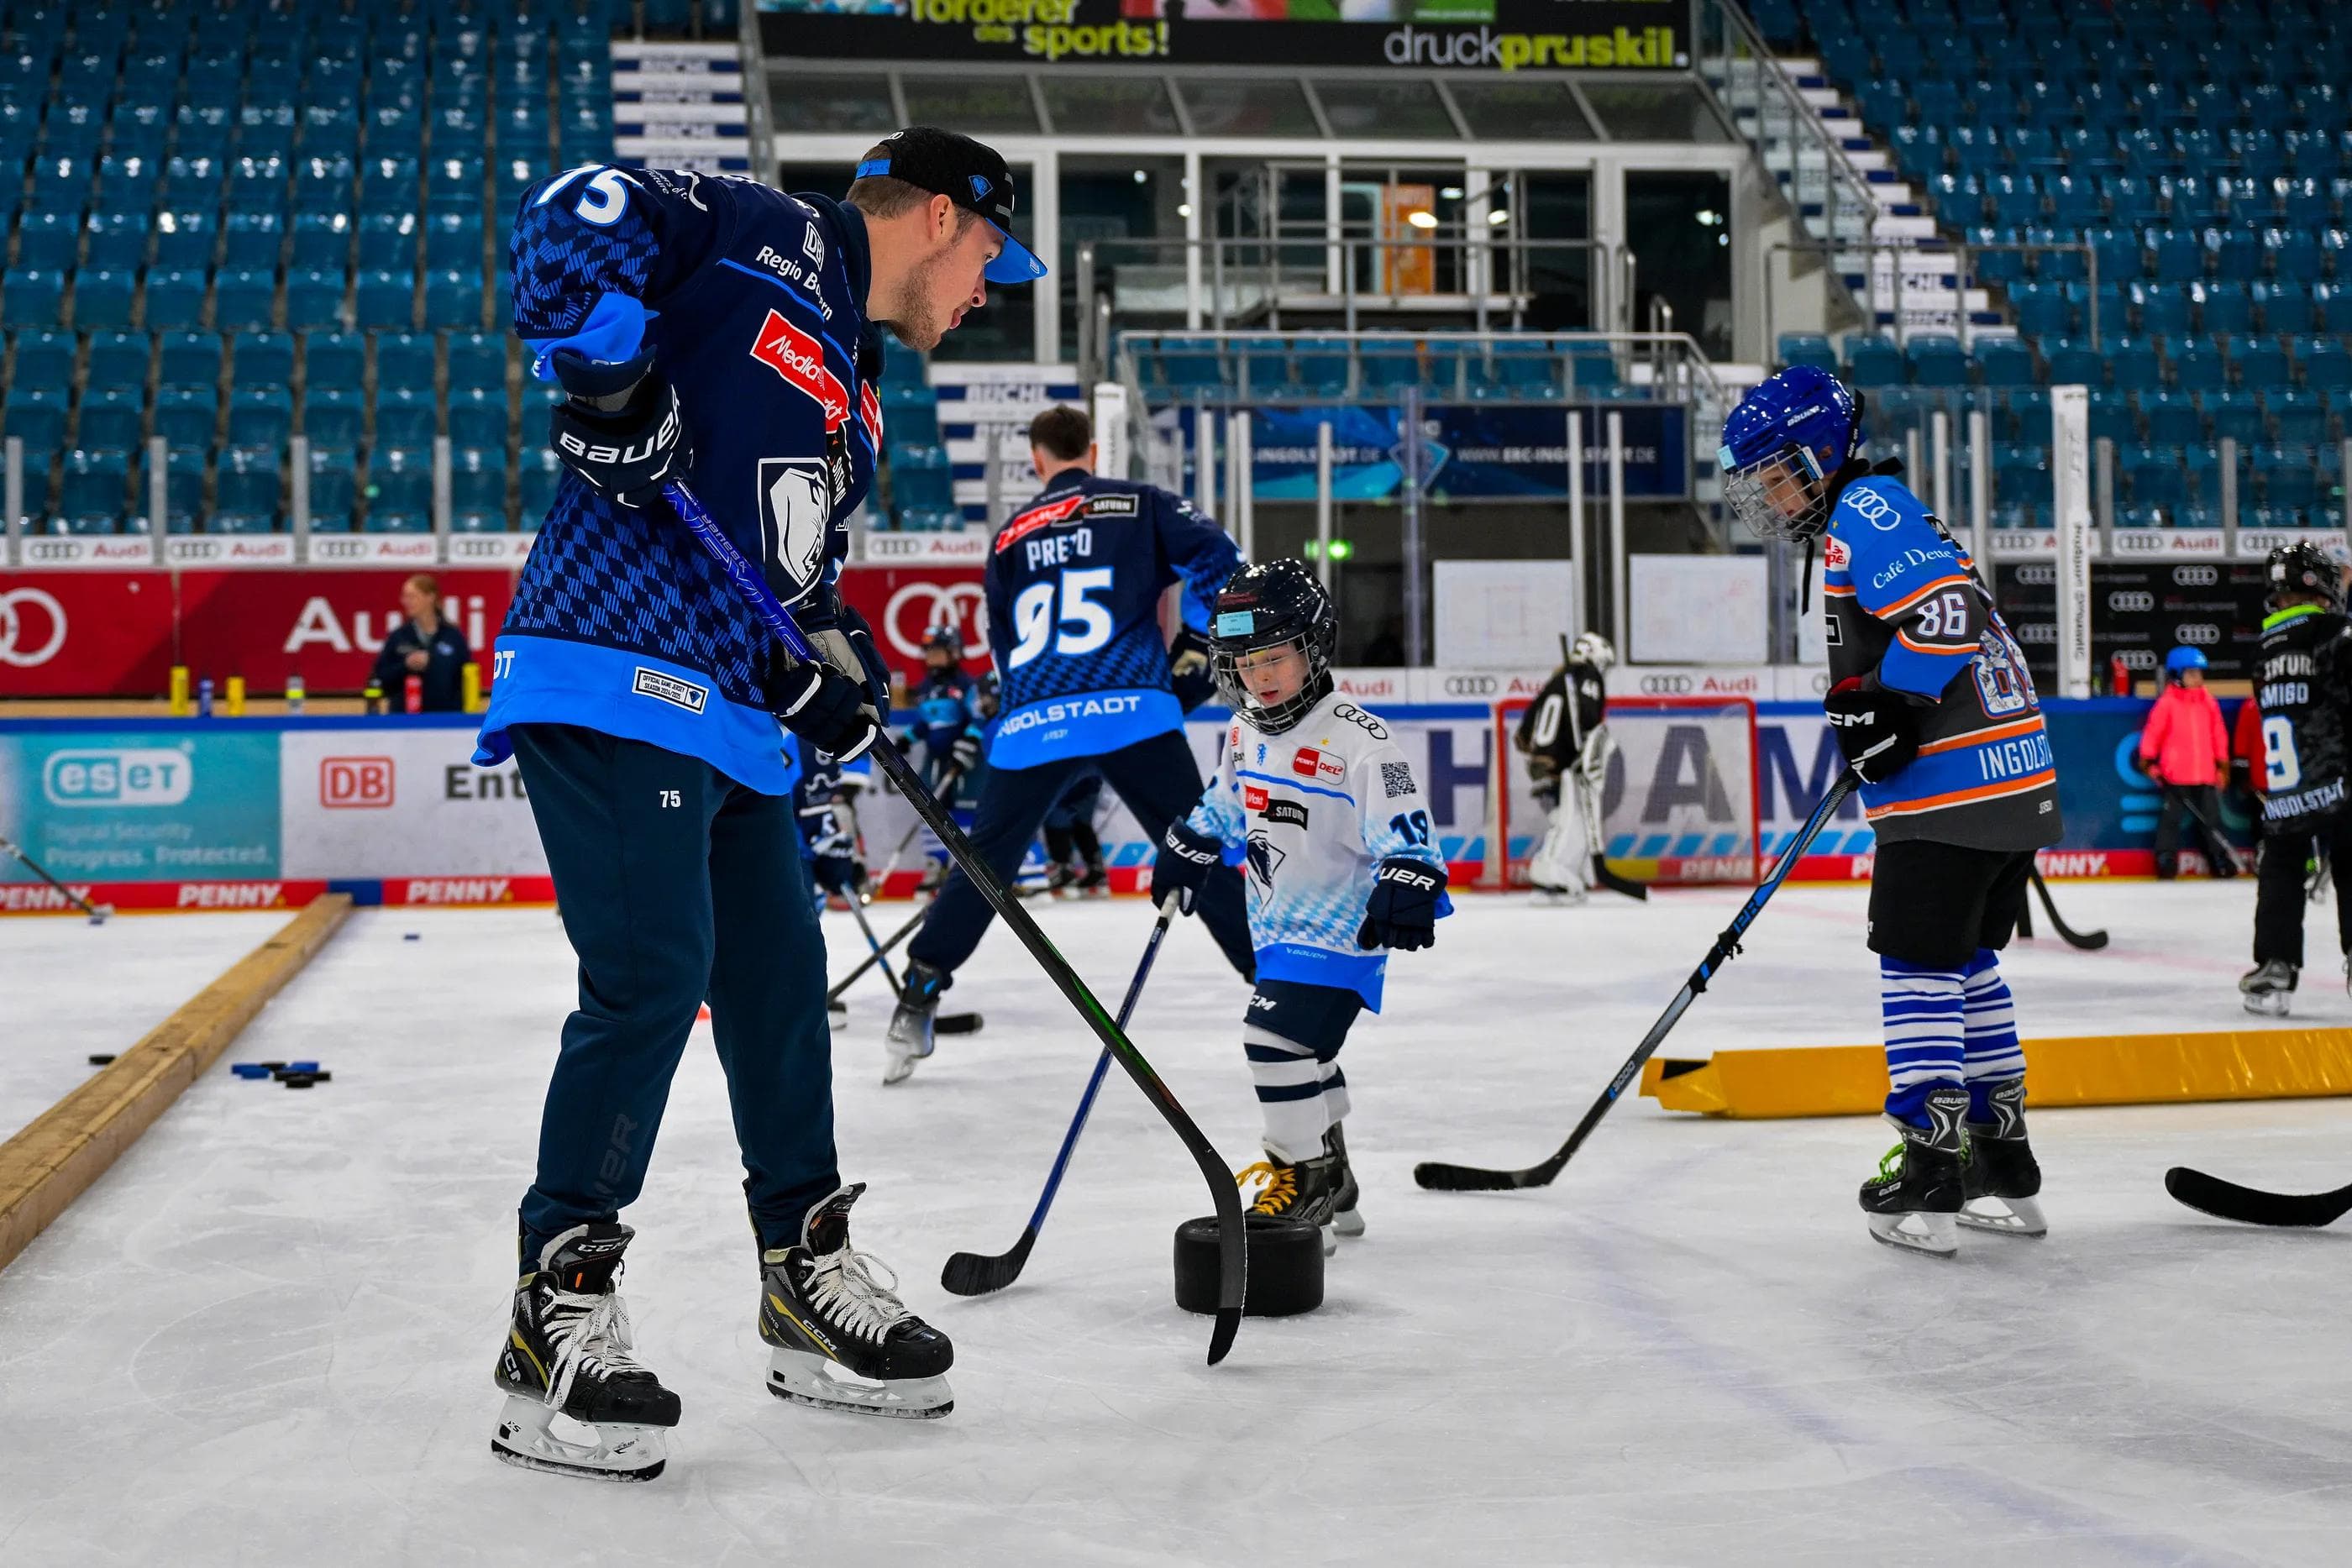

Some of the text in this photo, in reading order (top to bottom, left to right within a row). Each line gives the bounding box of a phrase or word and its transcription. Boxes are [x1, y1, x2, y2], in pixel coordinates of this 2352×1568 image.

[1023, 19, 1169, 61] sports!
[756, 245, 802, 281] Regio
[92, 542, 149, 559] Audi
[231, 541, 287, 559] Audi
[377, 540, 433, 558] Audi
[930, 538, 983, 554] Audi
[2171, 536, 2220, 551] Audi
[1872, 559, 1906, 590] Café
[1009, 566, 1115, 669] 95
[1915, 592, 1968, 637] 86
[1339, 678, 1394, 697] Audi
[1702, 675, 1758, 693] Audi
[995, 695, 1142, 739] NGOLSTADT
[1825, 711, 1876, 726] CM
[329, 765, 387, 800] DB
[659, 789, 682, 809] 75
[1165, 831, 1219, 866] AUER
[1378, 866, 1436, 892] UER
[1248, 994, 1278, 1011] CM
[801, 1319, 838, 1352] CCM
